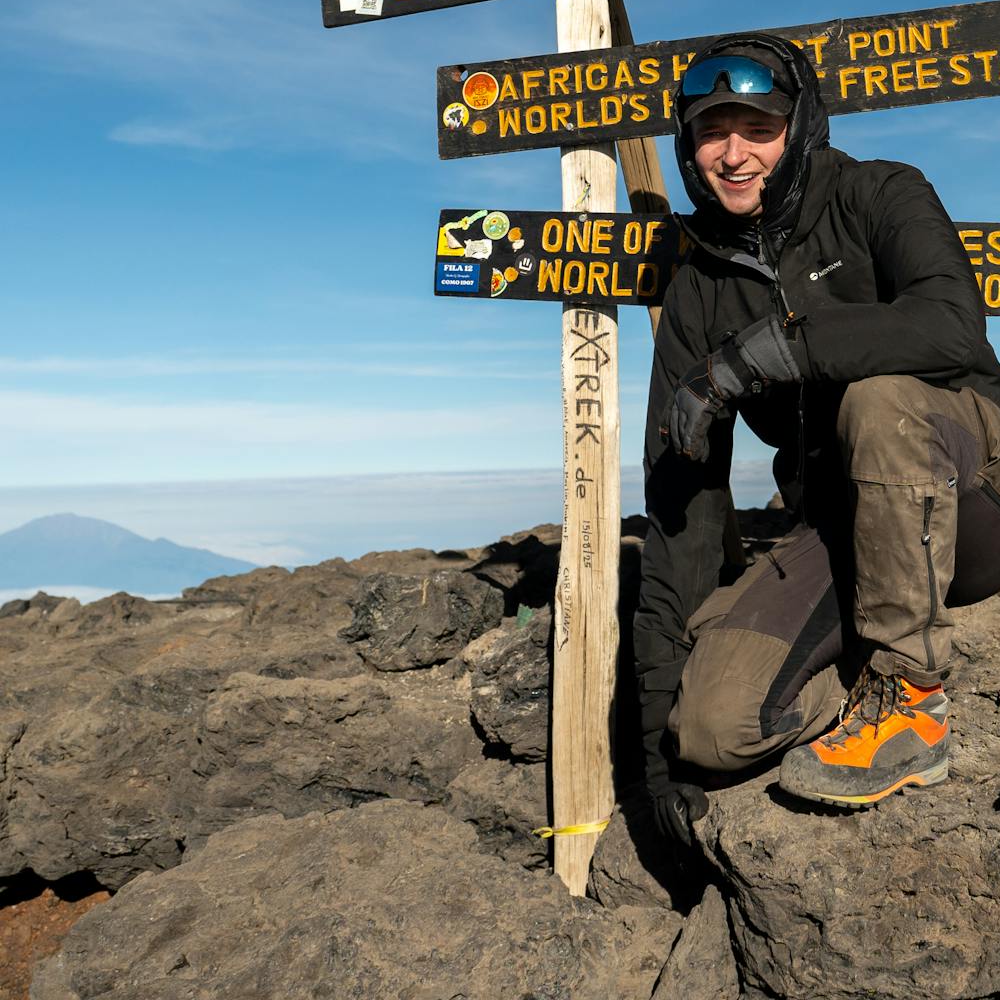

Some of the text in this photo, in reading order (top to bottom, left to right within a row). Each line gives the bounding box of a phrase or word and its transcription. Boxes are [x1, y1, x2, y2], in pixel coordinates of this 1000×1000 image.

[849, 19, 957, 61] POINT
[499, 58, 661, 102] AFRICAS
[499, 93, 650, 138] WORLD'S
[838, 57, 943, 98] FREE
[542, 218, 615, 254] ONE
[623, 220, 668, 254] OF
[464, 264, 474, 272] 12
[537, 259, 658, 297] WORLD
